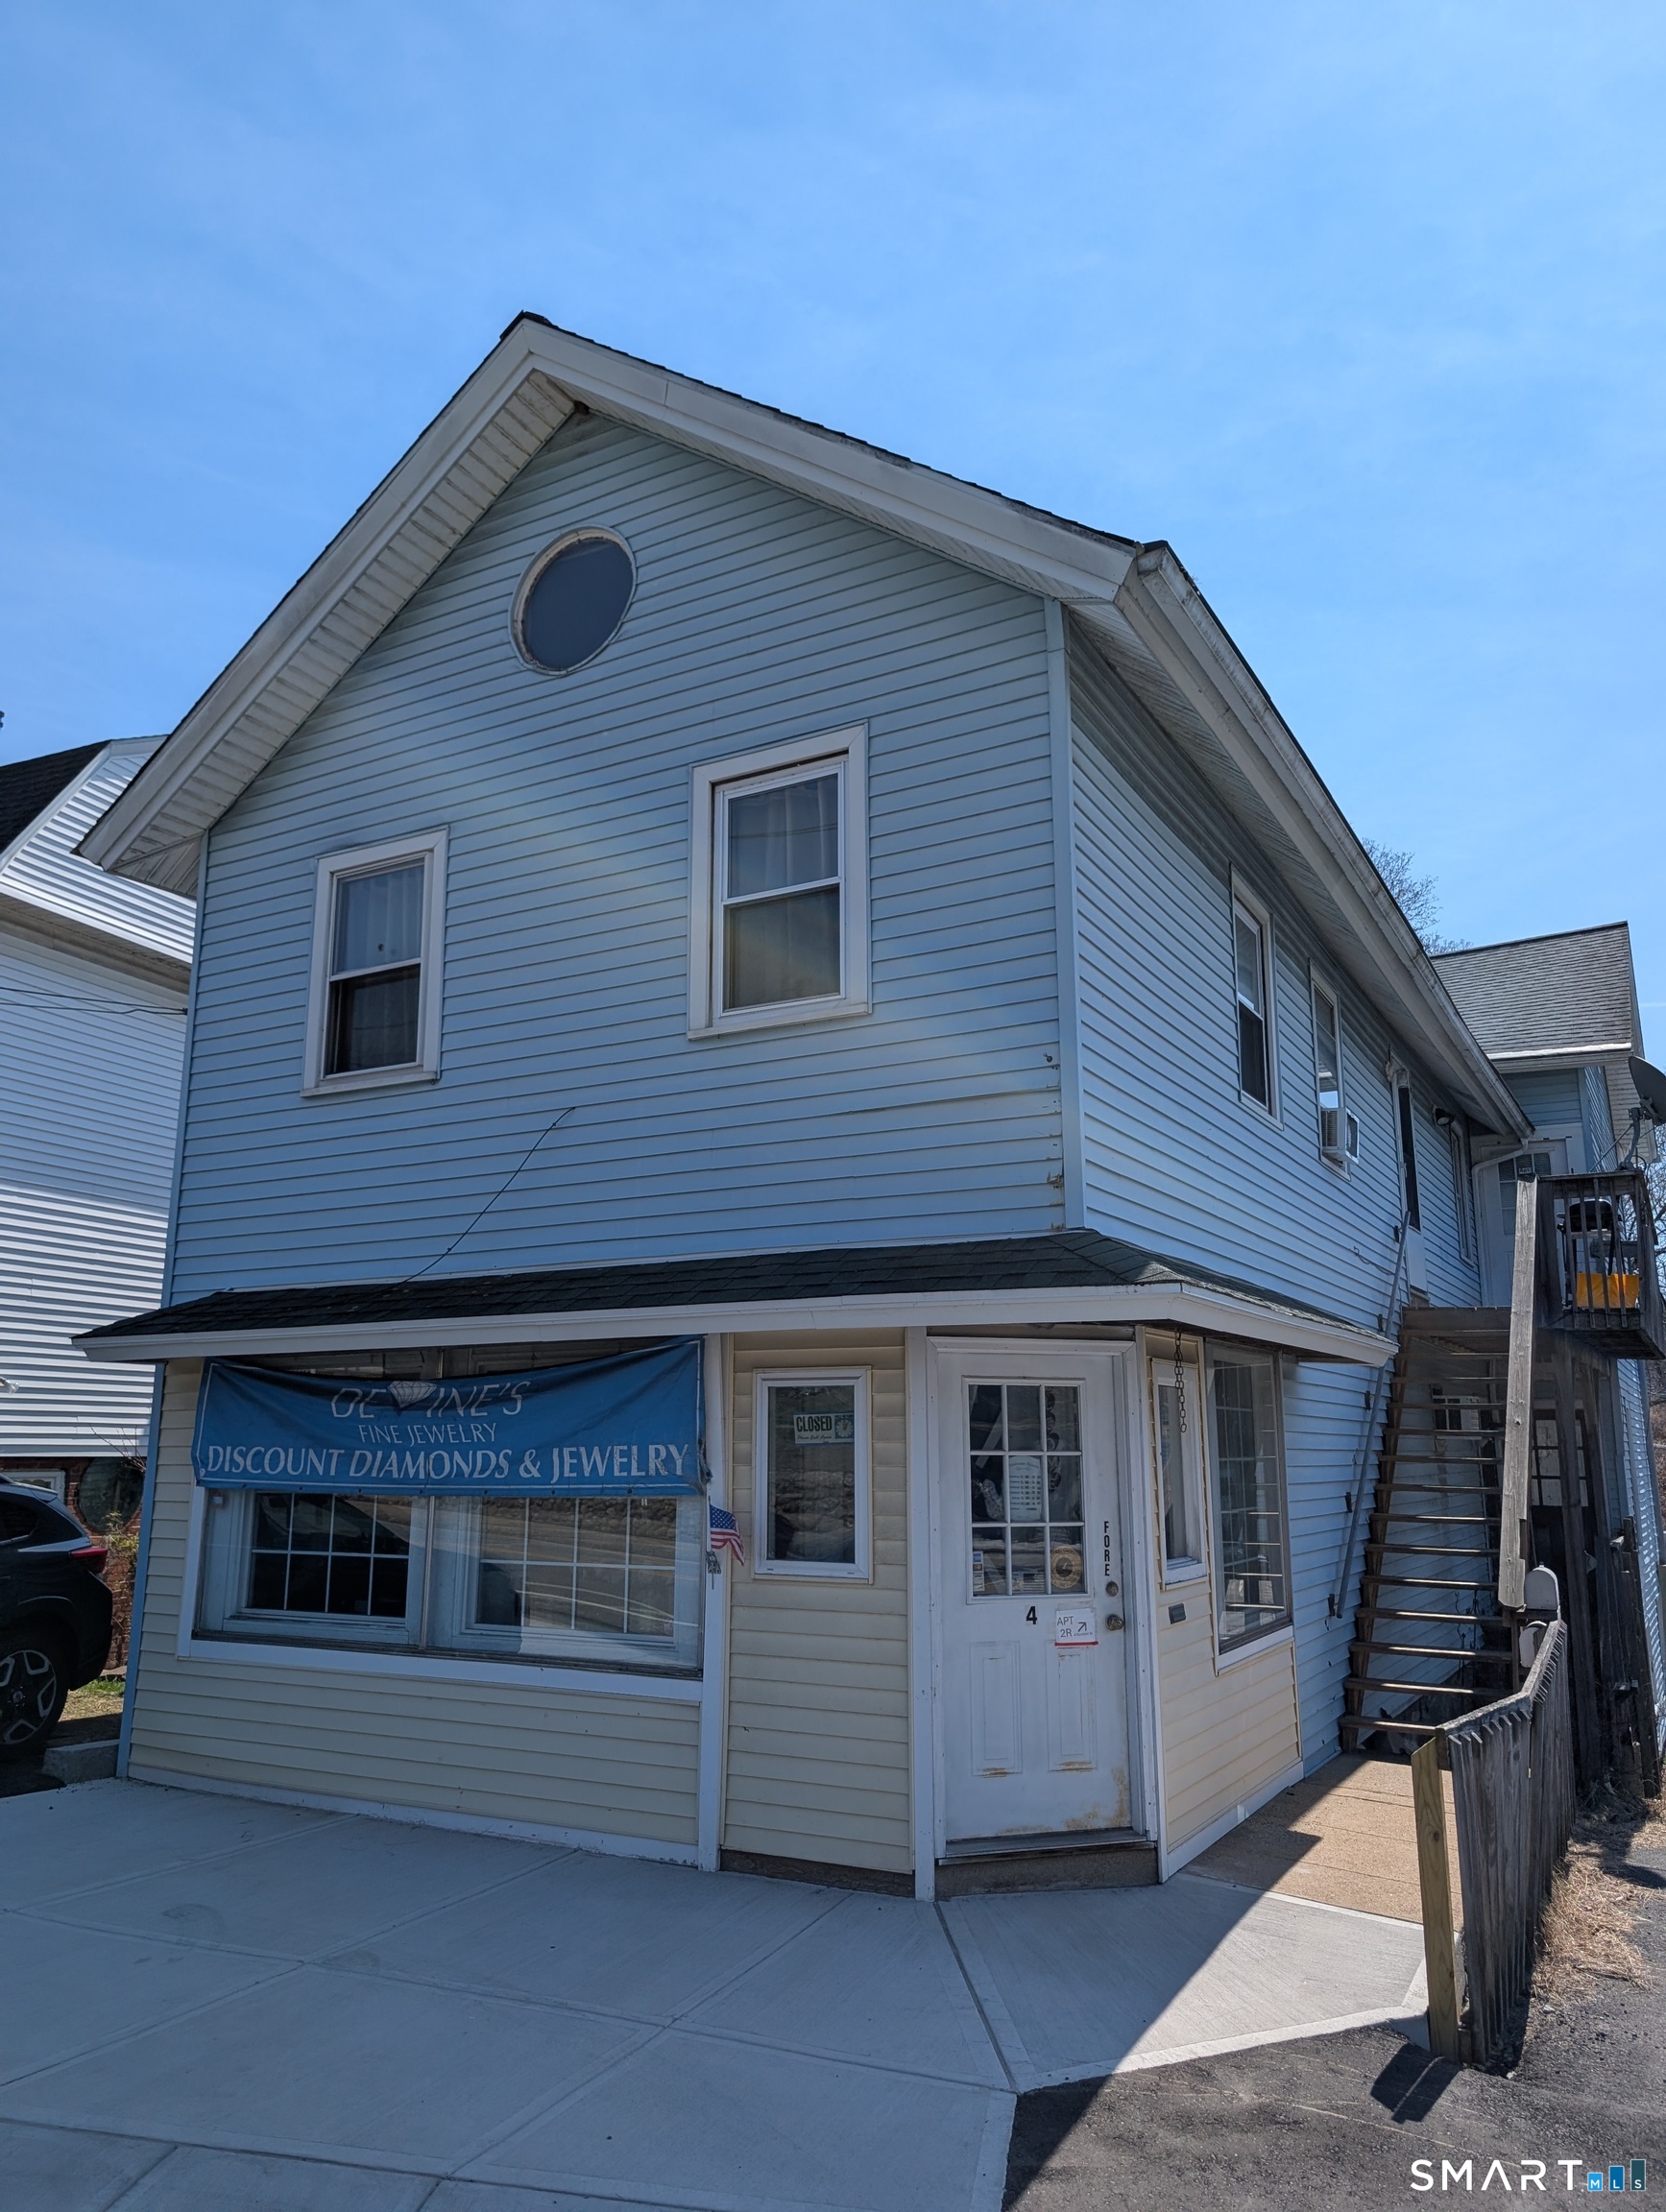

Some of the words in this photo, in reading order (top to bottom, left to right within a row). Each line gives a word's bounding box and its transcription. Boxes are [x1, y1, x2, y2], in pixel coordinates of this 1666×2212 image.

[796, 1415, 833, 1432] CLOSED
[358, 1425, 402, 1444] FINE
[406, 1422, 496, 1447] JEWELRY
[206, 1445, 345, 1477] DISCOUNT
[349, 1449, 512, 1479] DIAMONDS
[519, 1449, 542, 1479] &
[550, 1443, 688, 1484] JEWELRY
[1026, 1606, 1038, 1625] 4
[1056, 1615, 1074, 1626] APT
[1060, 1628, 1073, 1638] 2R
